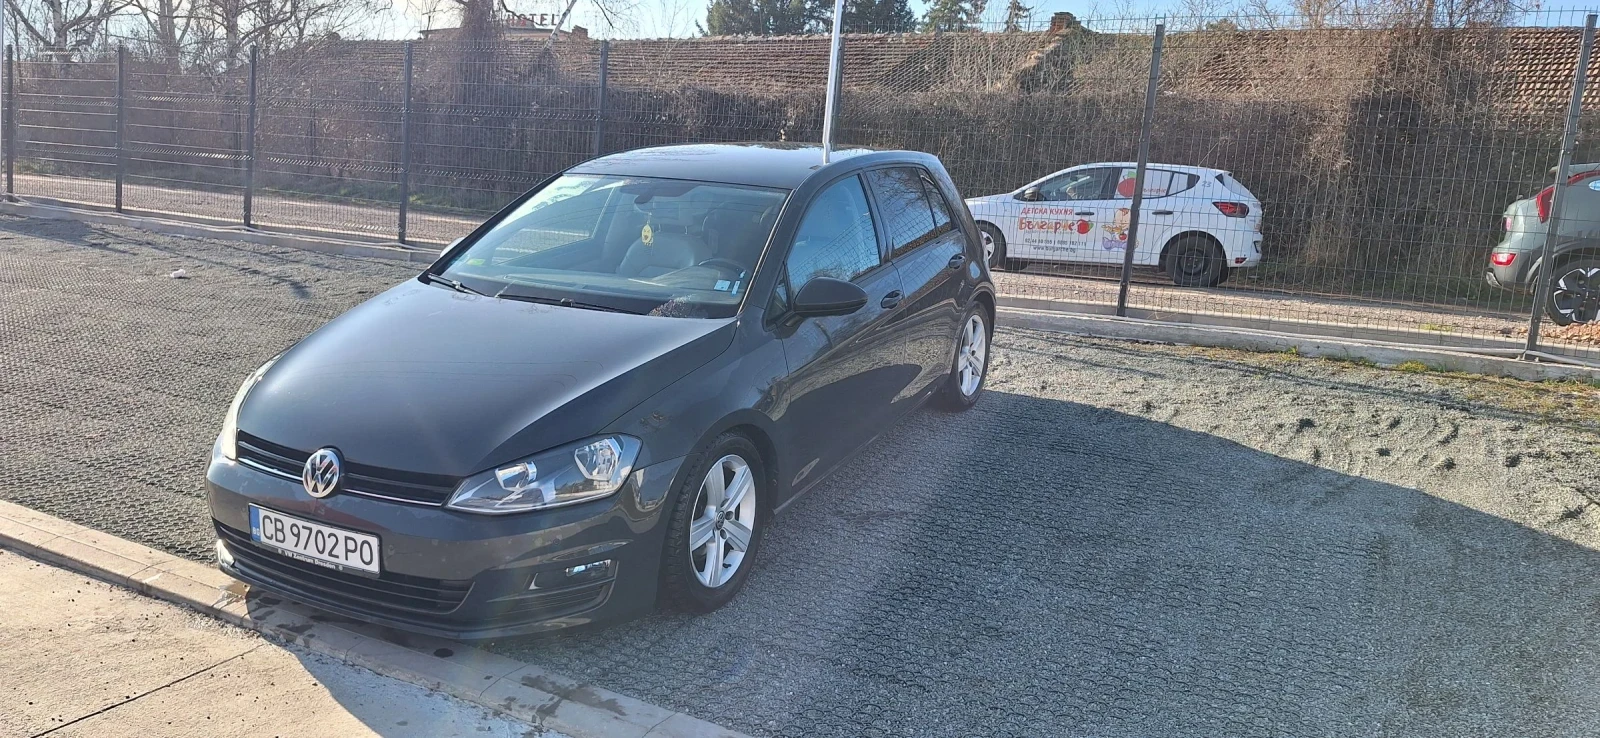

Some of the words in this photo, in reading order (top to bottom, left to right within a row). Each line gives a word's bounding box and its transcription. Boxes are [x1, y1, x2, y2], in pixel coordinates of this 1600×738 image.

[1020, 207, 1048, 215] ДЕТСКА
[1050, 208, 1074, 216] КУХНЯ
[262, 514, 286, 544] CB
[290, 523, 340, 559] 9702
[344, 535, 374, 566] PO
[293, 553, 315, 564] Zentrum
[314, 559, 336, 570] Dresden
